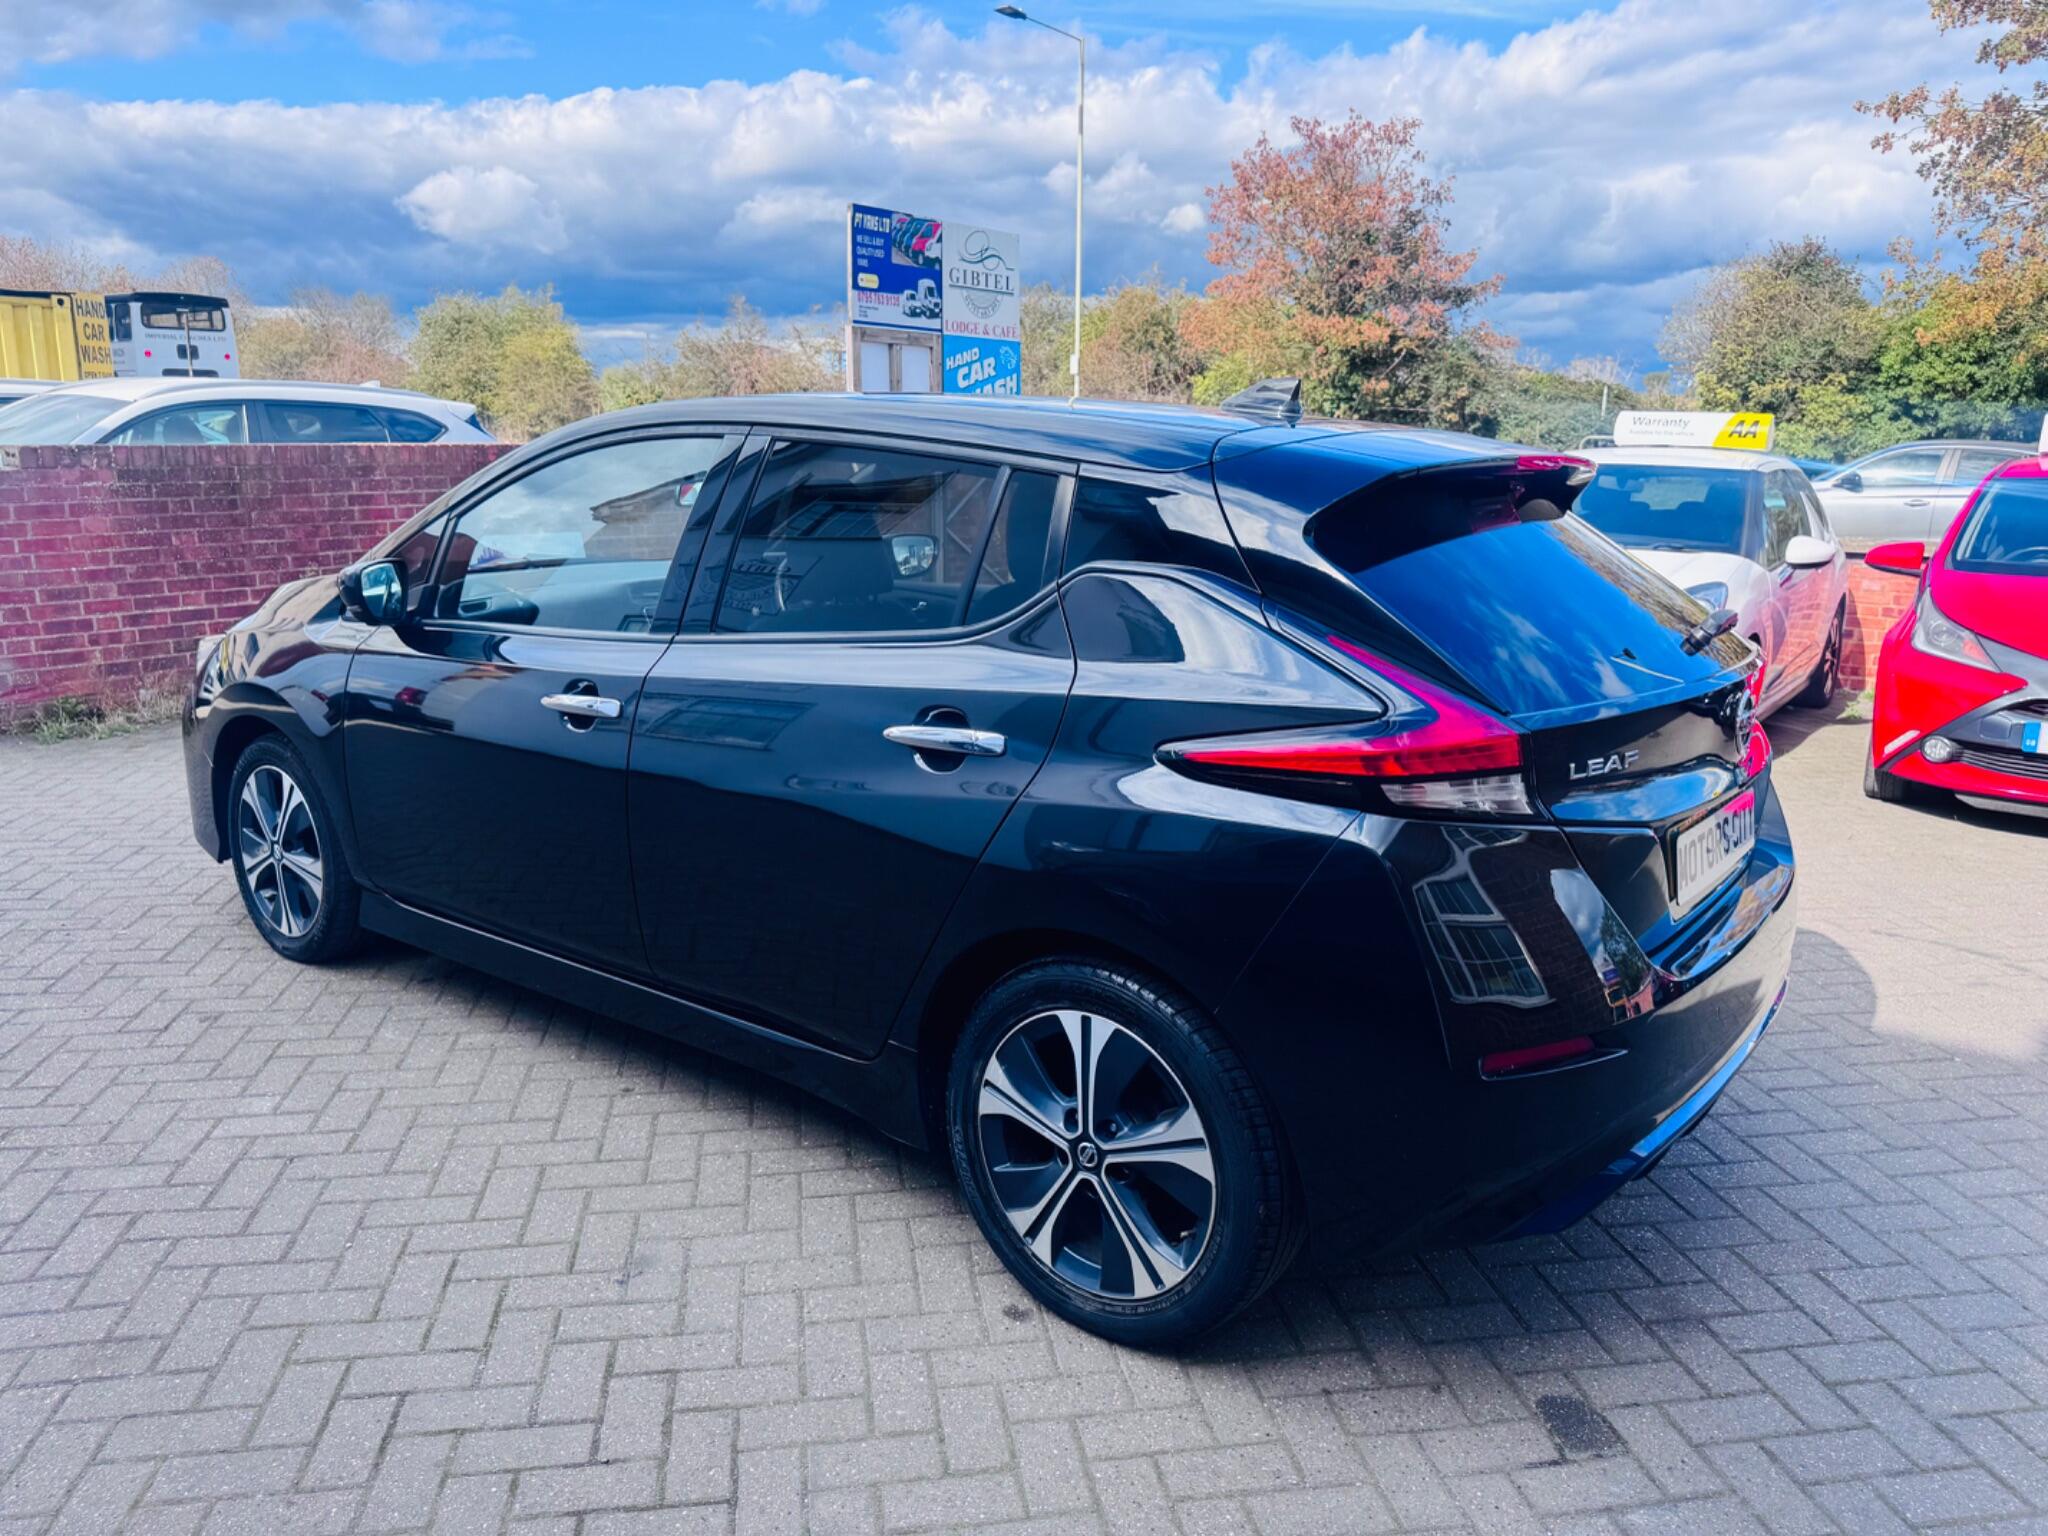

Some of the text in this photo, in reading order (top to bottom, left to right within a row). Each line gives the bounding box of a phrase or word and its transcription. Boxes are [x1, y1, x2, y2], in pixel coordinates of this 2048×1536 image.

[949, 266, 1015, 292] GIBTEL
[75, 299, 105, 318] HAND
[83, 322, 105, 342] CAR
[945, 319, 980, 335] LODGE
[983, 323, 990, 336] &
[80, 344, 113, 365] WASH
[946, 347, 980, 370] HAND
[957, 356, 997, 388] CAR
[975, 372, 1018, 395] ASH
[1632, 416, 1690, 429] Warranty
[1728, 419, 1760, 438] AA
[1569, 749, 1639, 780] LEAF
